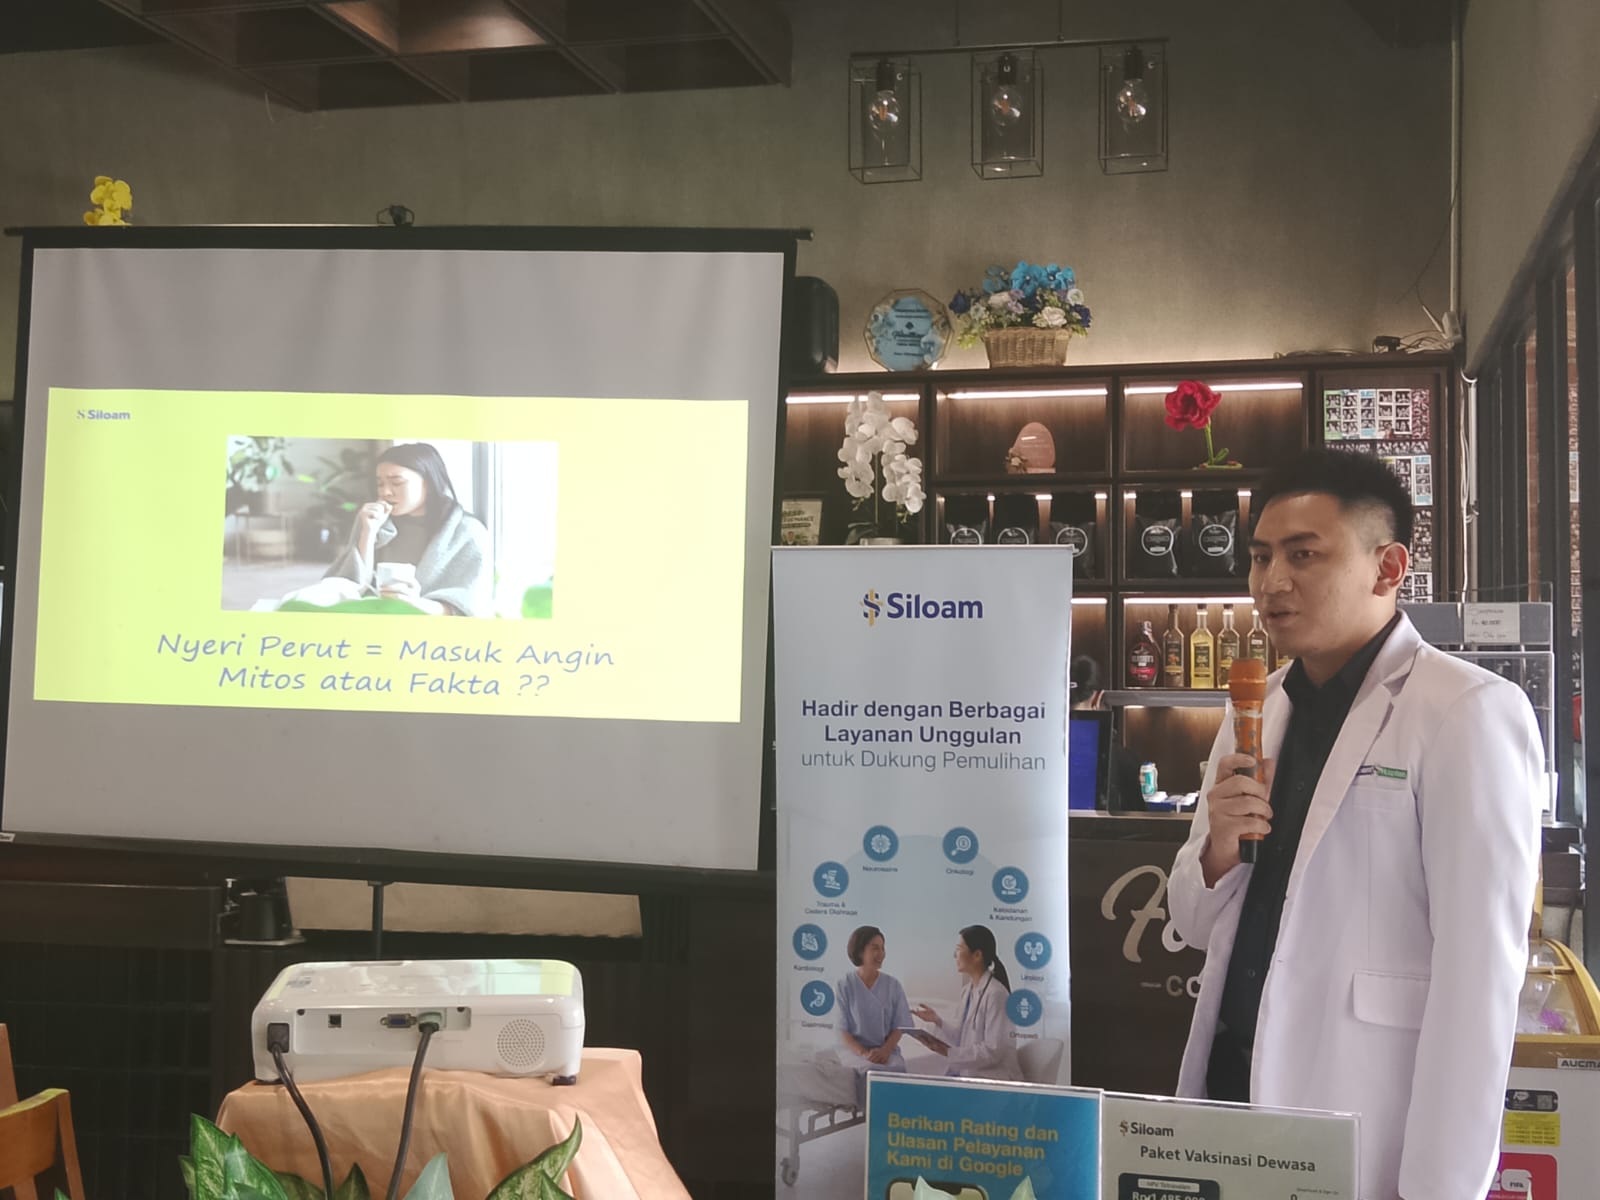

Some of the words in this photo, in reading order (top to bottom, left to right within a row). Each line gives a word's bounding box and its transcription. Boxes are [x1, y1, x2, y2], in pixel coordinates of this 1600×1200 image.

[88, 409, 130, 420] Siloam
[887, 592, 983, 619] Siloam
[157, 633, 247, 662] Nyeri
[259, 636, 351, 659] Perut
[399, 640, 502, 664] Masuk
[516, 643, 614, 673] Angin
[218, 667, 305, 690] Mitos
[320, 672, 392, 692] atau
[409, 672, 500, 695] Fakta
[802, 699, 858, 717] Hadir
[864, 700, 943, 721] dengan
[949, 701, 1046, 722] Berbagai
[825, 725, 913, 745] Layanan
[919, 726, 1022, 747] Unggulan
[801, 750, 855, 767] untuk
[861, 750, 936, 772] Dukung
[943, 750, 1046, 771] Pemulihan
[887, 1112, 955, 1133] Berikan
[960, 1118, 1019, 1141] Rating
[1024, 1125, 1058, 1142] dan
[1130, 1122, 1174, 1137] Siloam
[887, 1131, 947, 1150] Ulasan
[953, 1137, 1045, 1160] Pelayanan
[1140, 1145, 1180, 1161] Paket
[1185, 1149, 1252, 1167] Vaksinasi
[1257, 1155, 1316, 1172] Dewasa
[887, 1150, 931, 1169] Kami
[937, 1156, 953, 1170] di
[959, 1157, 1023, 1178] Google
